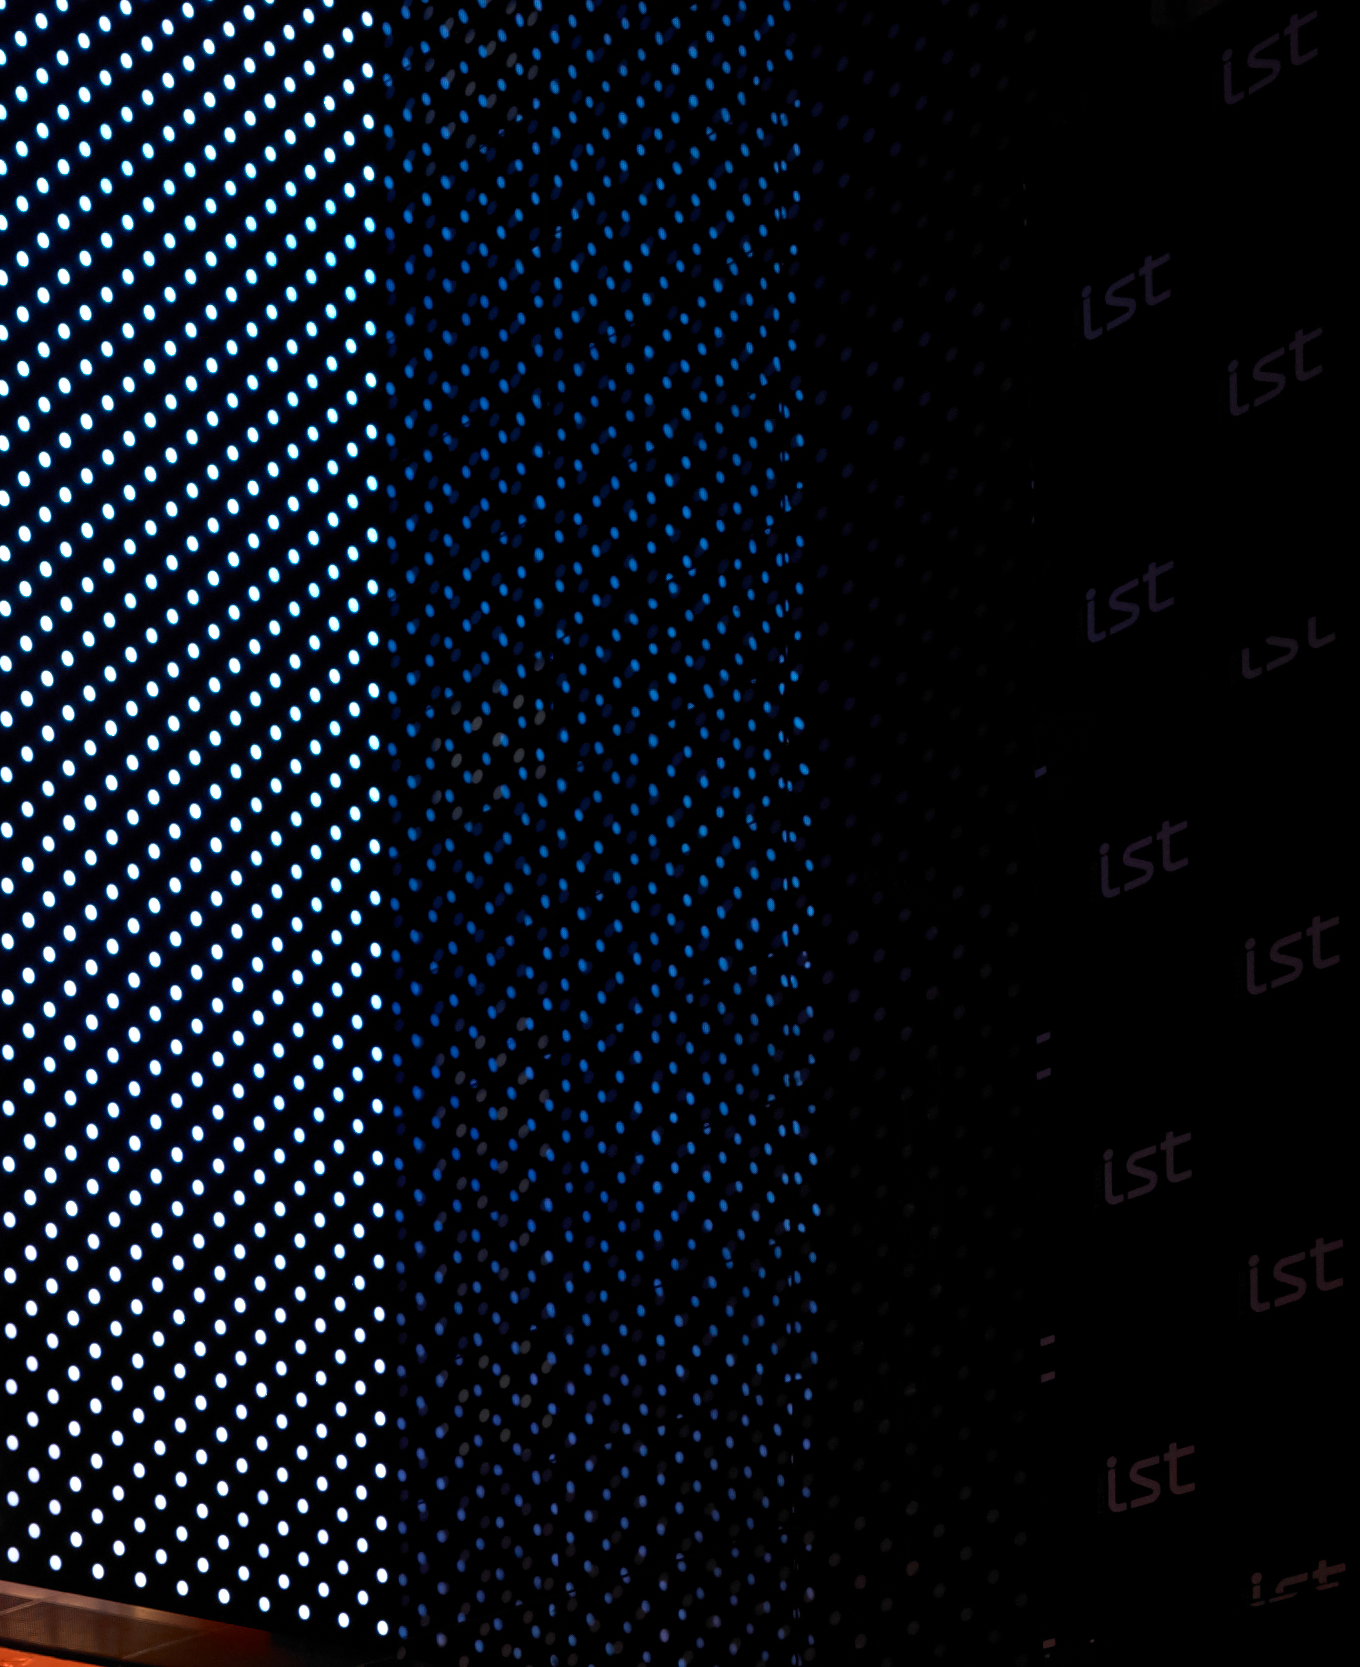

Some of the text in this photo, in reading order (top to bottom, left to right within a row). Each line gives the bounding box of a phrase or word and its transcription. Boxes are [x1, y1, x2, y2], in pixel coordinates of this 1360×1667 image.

[1224, 14, 1313, 103] ist
[1082, 254, 1169, 339] ist
[1229, 331, 1317, 415] ist
[1086, 562, 1173, 642] ist
[1100, 822, 1187, 897] ist
[1246, 917, 1338, 994] ist
[1104, 1132, 1191, 1204] ist
[1250, 1239, 1342, 1312] ist
[1108, 1443, 1195, 1512] ist
